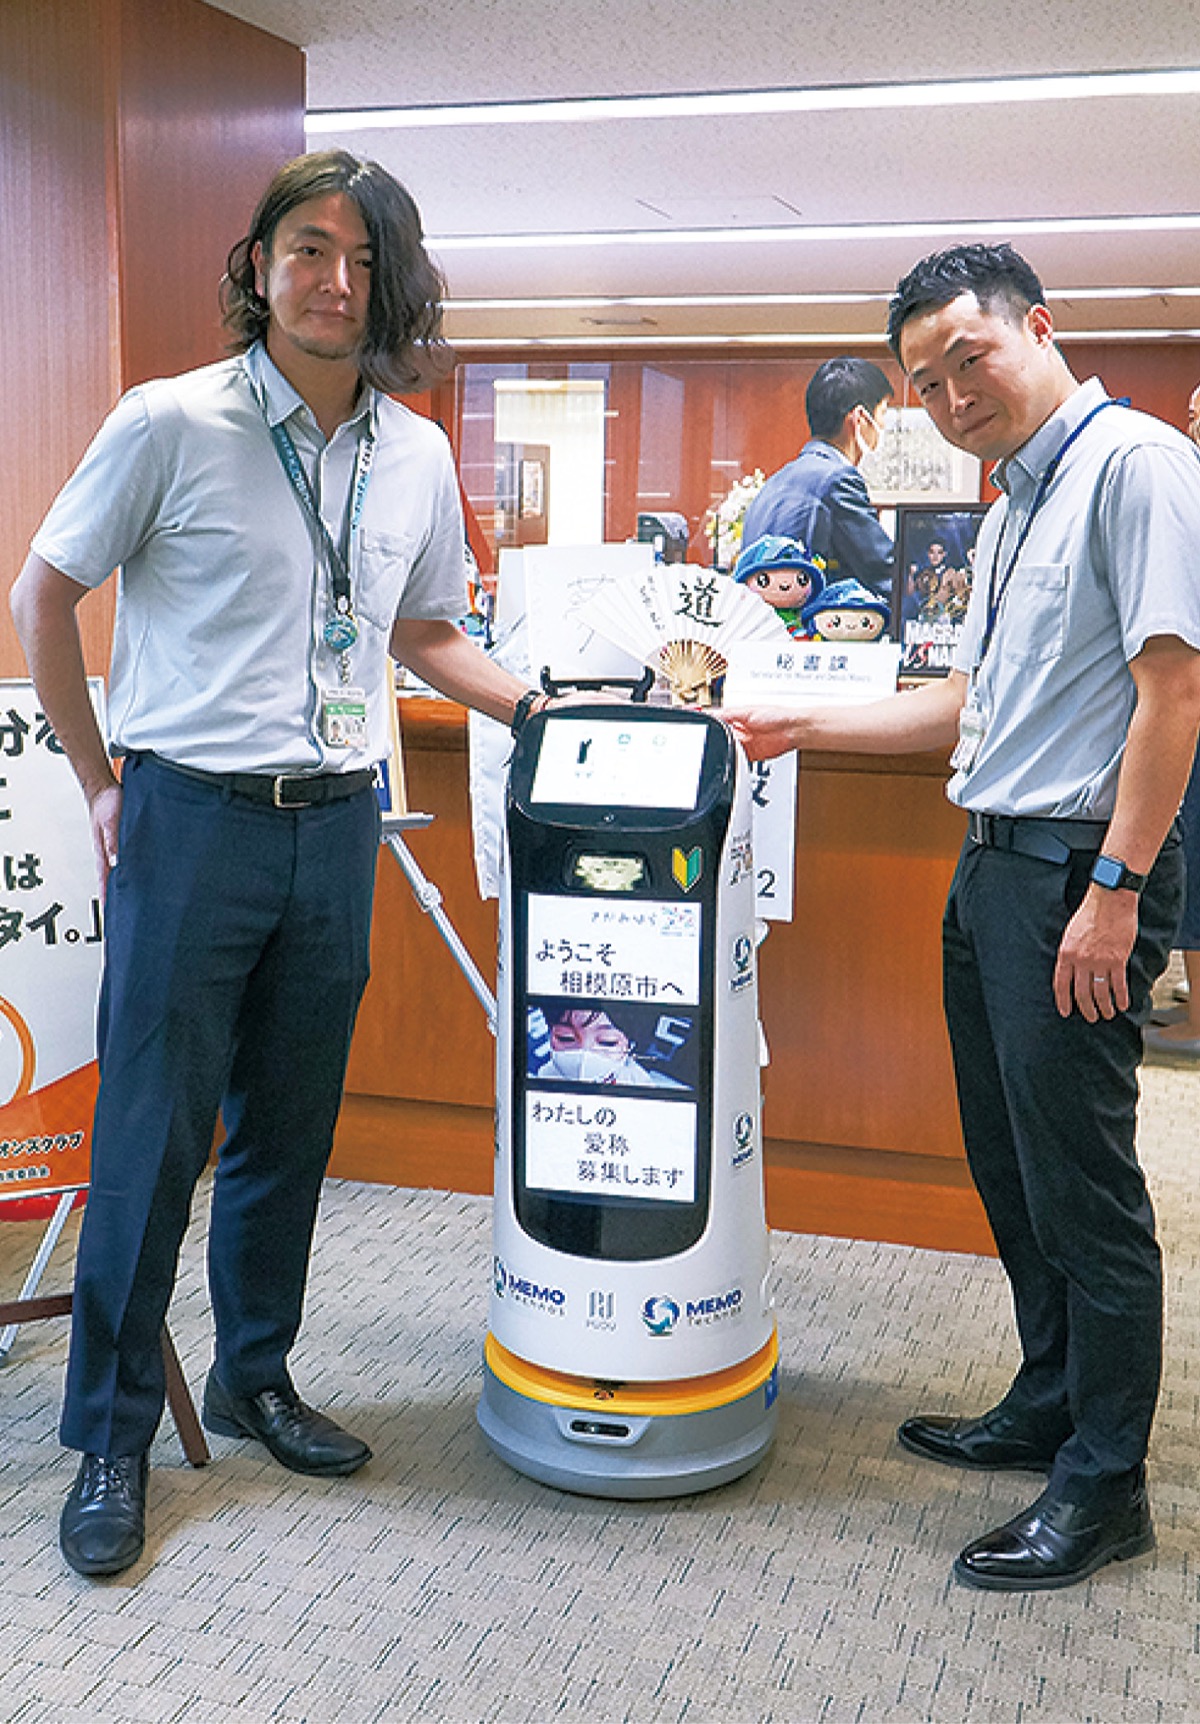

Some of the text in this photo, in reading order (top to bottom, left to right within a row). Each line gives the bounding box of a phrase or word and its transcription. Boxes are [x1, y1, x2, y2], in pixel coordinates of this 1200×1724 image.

[672, 576, 724, 628] 道
[756, 869, 776, 898] 2
[535, 939, 616, 966] ようこそ
[560, 970, 684, 998] 相模原市へ
[532, 1101, 617, 1126] わたしの
[584, 1132, 630, 1156] 愛称
[577, 1159, 684, 1188] 募集します
[509, 1275, 565, 1305] MEMO
[686, 1289, 742, 1316] MEMO
